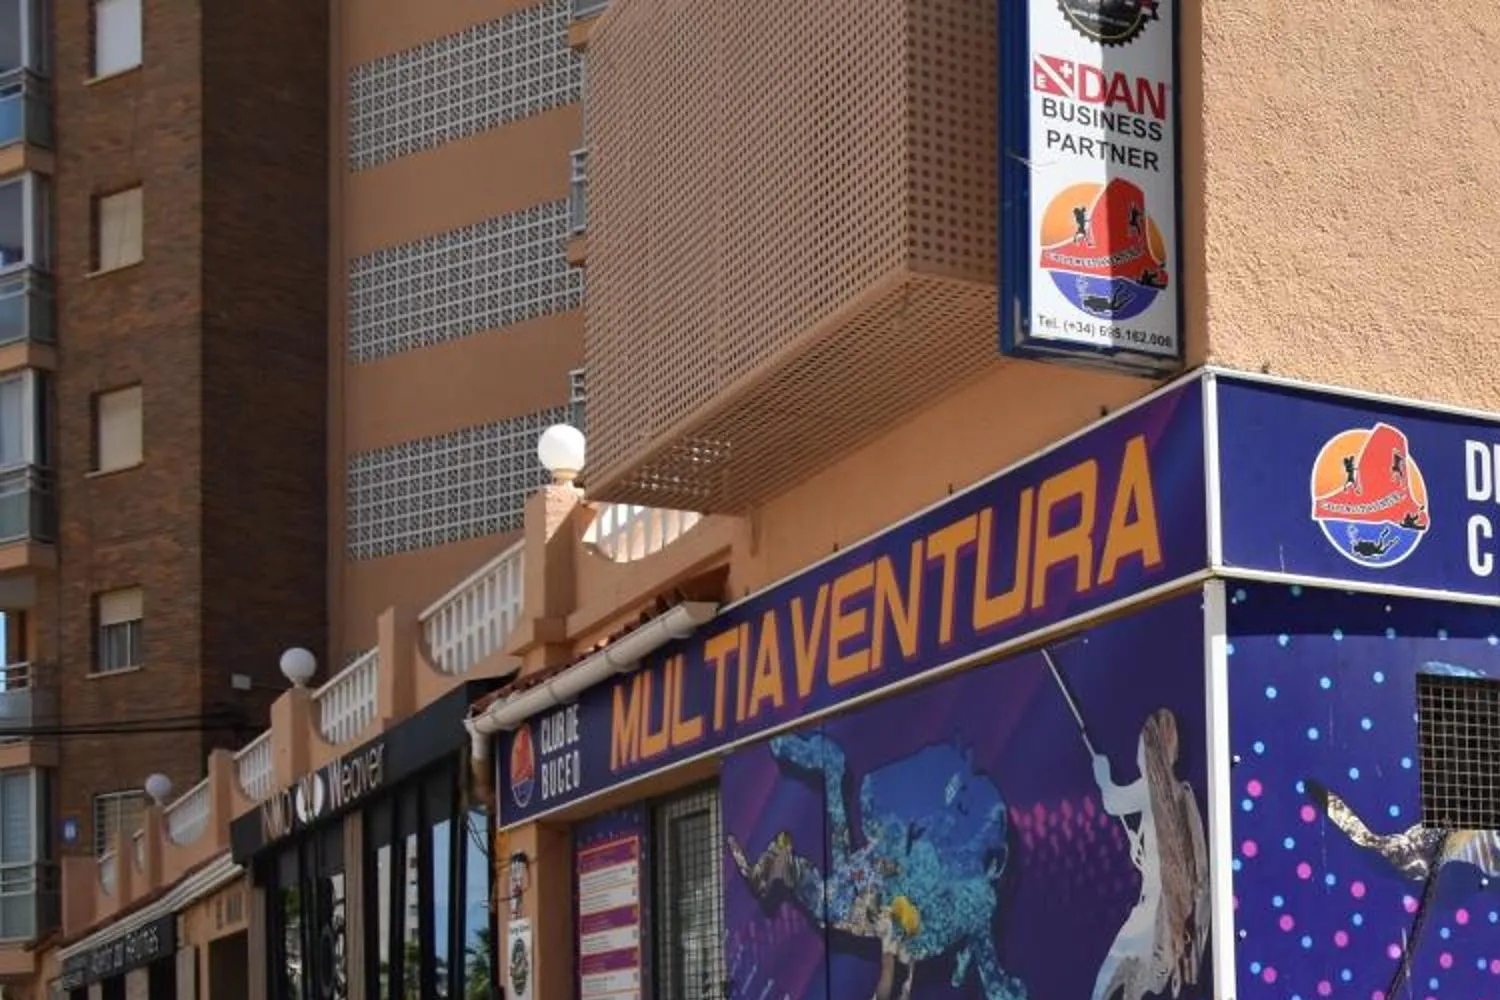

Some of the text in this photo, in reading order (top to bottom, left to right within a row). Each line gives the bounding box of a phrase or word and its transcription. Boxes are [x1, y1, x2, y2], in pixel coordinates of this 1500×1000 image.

[1078, 63, 1165, 121] DAN
[1042, 97, 1163, 142] BUSINESS
[1046, 129, 1159, 173] PARTNER
[610, 435, 1163, 771] MULTIAVENTURA
[541, 703, 579, 756] CLUB DE
[541, 749, 580, 801] BUCEO
